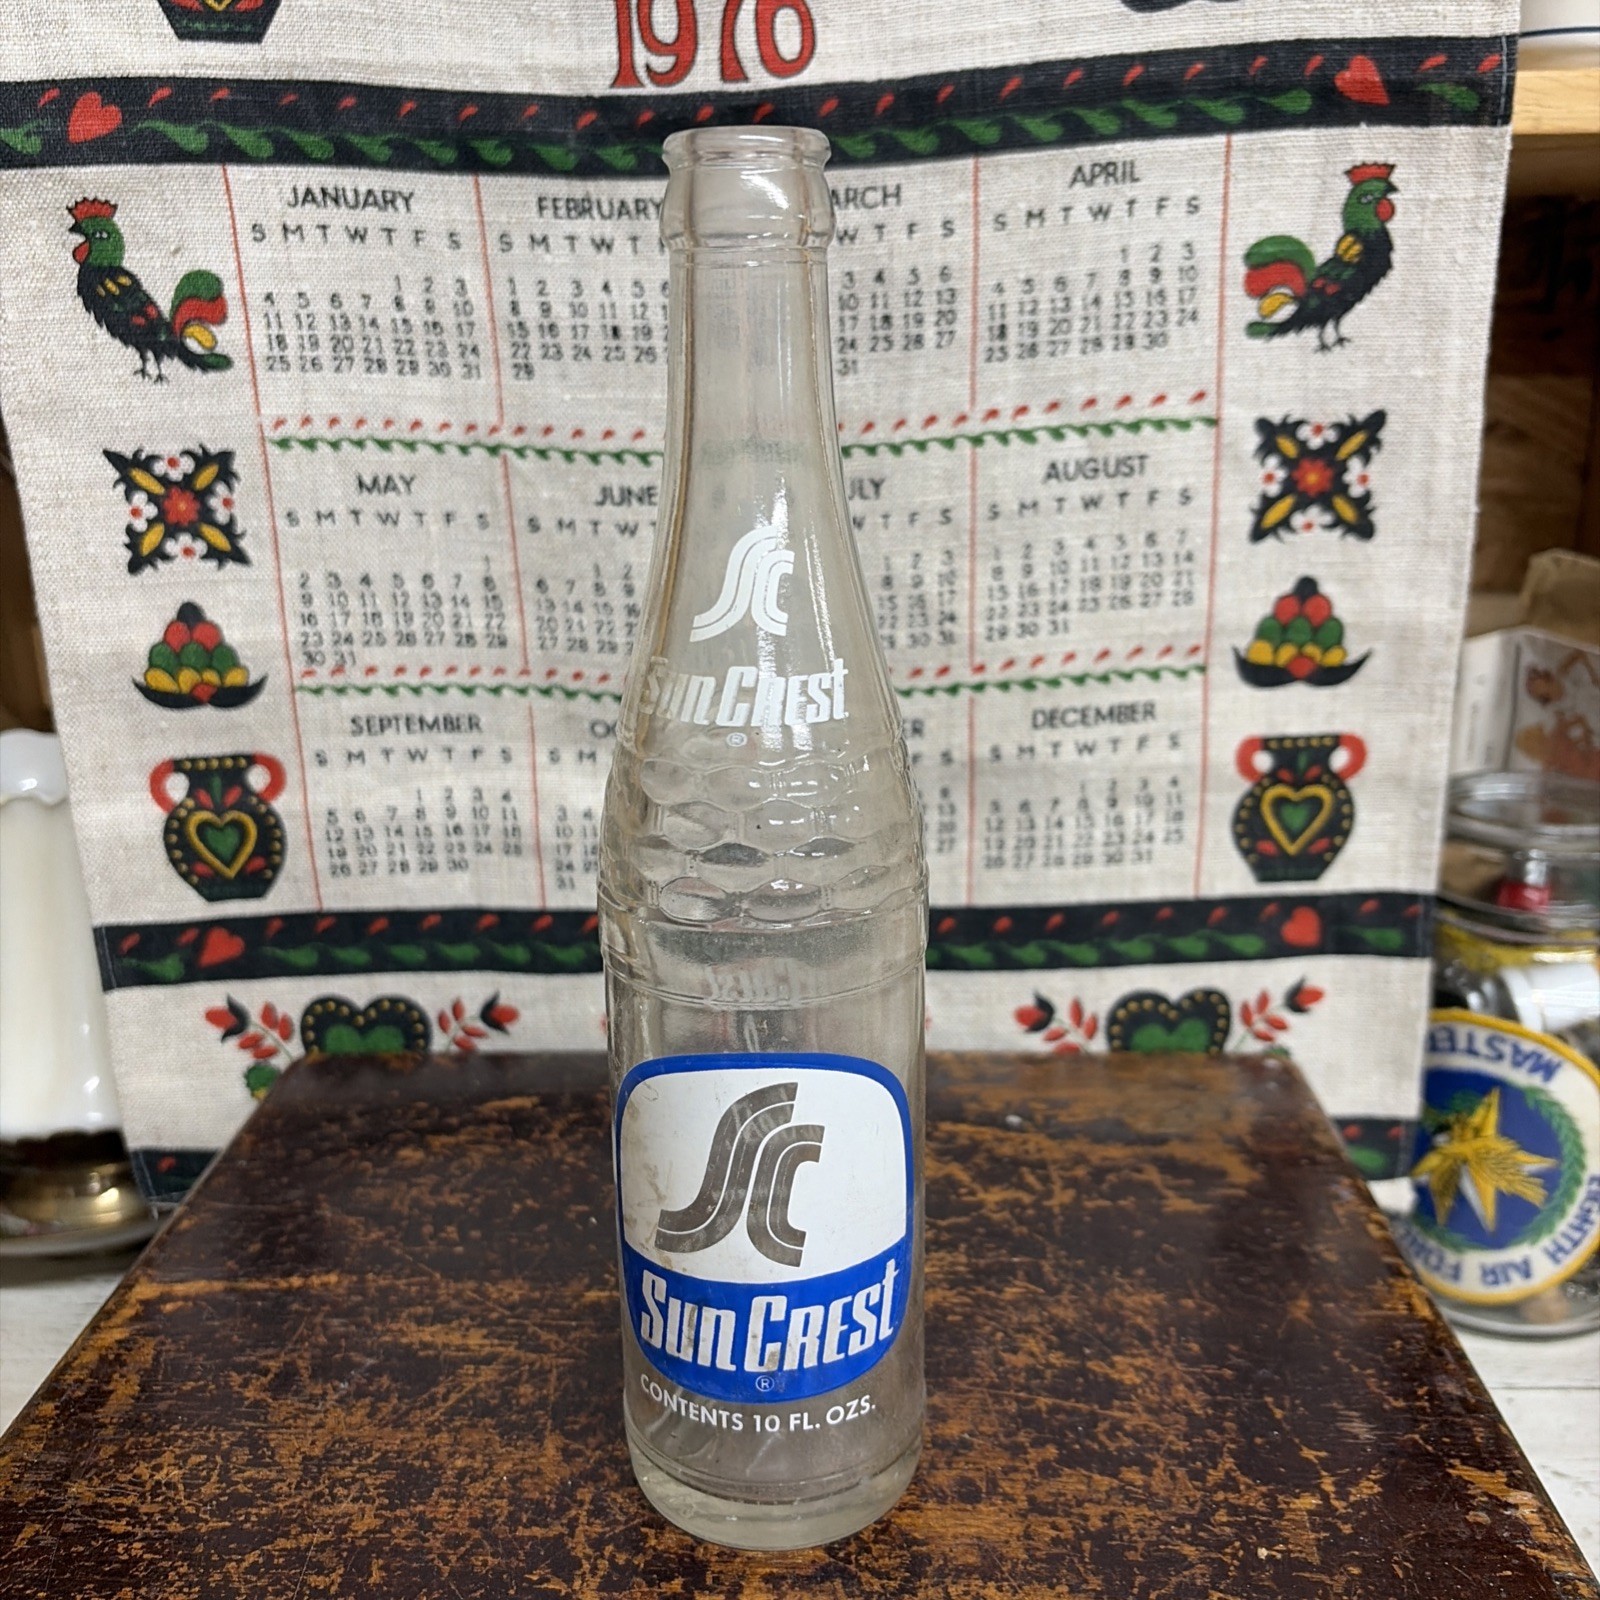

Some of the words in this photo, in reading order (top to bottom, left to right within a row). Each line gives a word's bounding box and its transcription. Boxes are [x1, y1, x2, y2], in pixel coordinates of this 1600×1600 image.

[1069, 161, 1140, 189] APRIL
[287, 185, 414, 213] JANUARY
[537, 196, 663, 220] FEBRUARY
[831, 184, 901, 210] ARCH
[994, 213, 1007, 231] S
[1025, 209, 1046, 228] M
[1061, 207, 1074, 225] T
[1088, 205, 1112, 222] W
[1126, 199, 1138, 217] T
[1156, 198, 1169, 216] F
[1187, 197, 1199, 215] S
[252, 223, 266, 242] S
[282, 223, 304, 243] M
[316, 225, 330, 243] T
[345, 226, 368, 244] W
[381, 228, 397, 245] T
[414, 230, 426, 246] F
[449, 232, 461, 250] S
[500, 234, 513, 253] S
[530, 234, 549, 253] M
[564, 235, 578, 253] T
[590, 237, 614, 255] W
[628, 236, 641, 255] T
[836, 228, 858, 245] W
[874, 224, 884, 241] T
[908, 223, 917, 240] F
[942, 220, 954, 237] S
[1042, 455, 1148, 484] AUGUST
[357, 474, 416, 495] MAY
[594, 486, 658, 507] JUNE
[350, 713, 483, 737] SEPTEMBER
[1032, 700, 1156, 730] DECEMBER
[1481, 1257, 1532, 1286] AIR
[641, 1374, 744, 1431] CONTENTS
[753, 1414, 780, 1432] 10
[789, 1412, 820, 1431] FL.
[826, 1394, 876, 1426] OZS.
